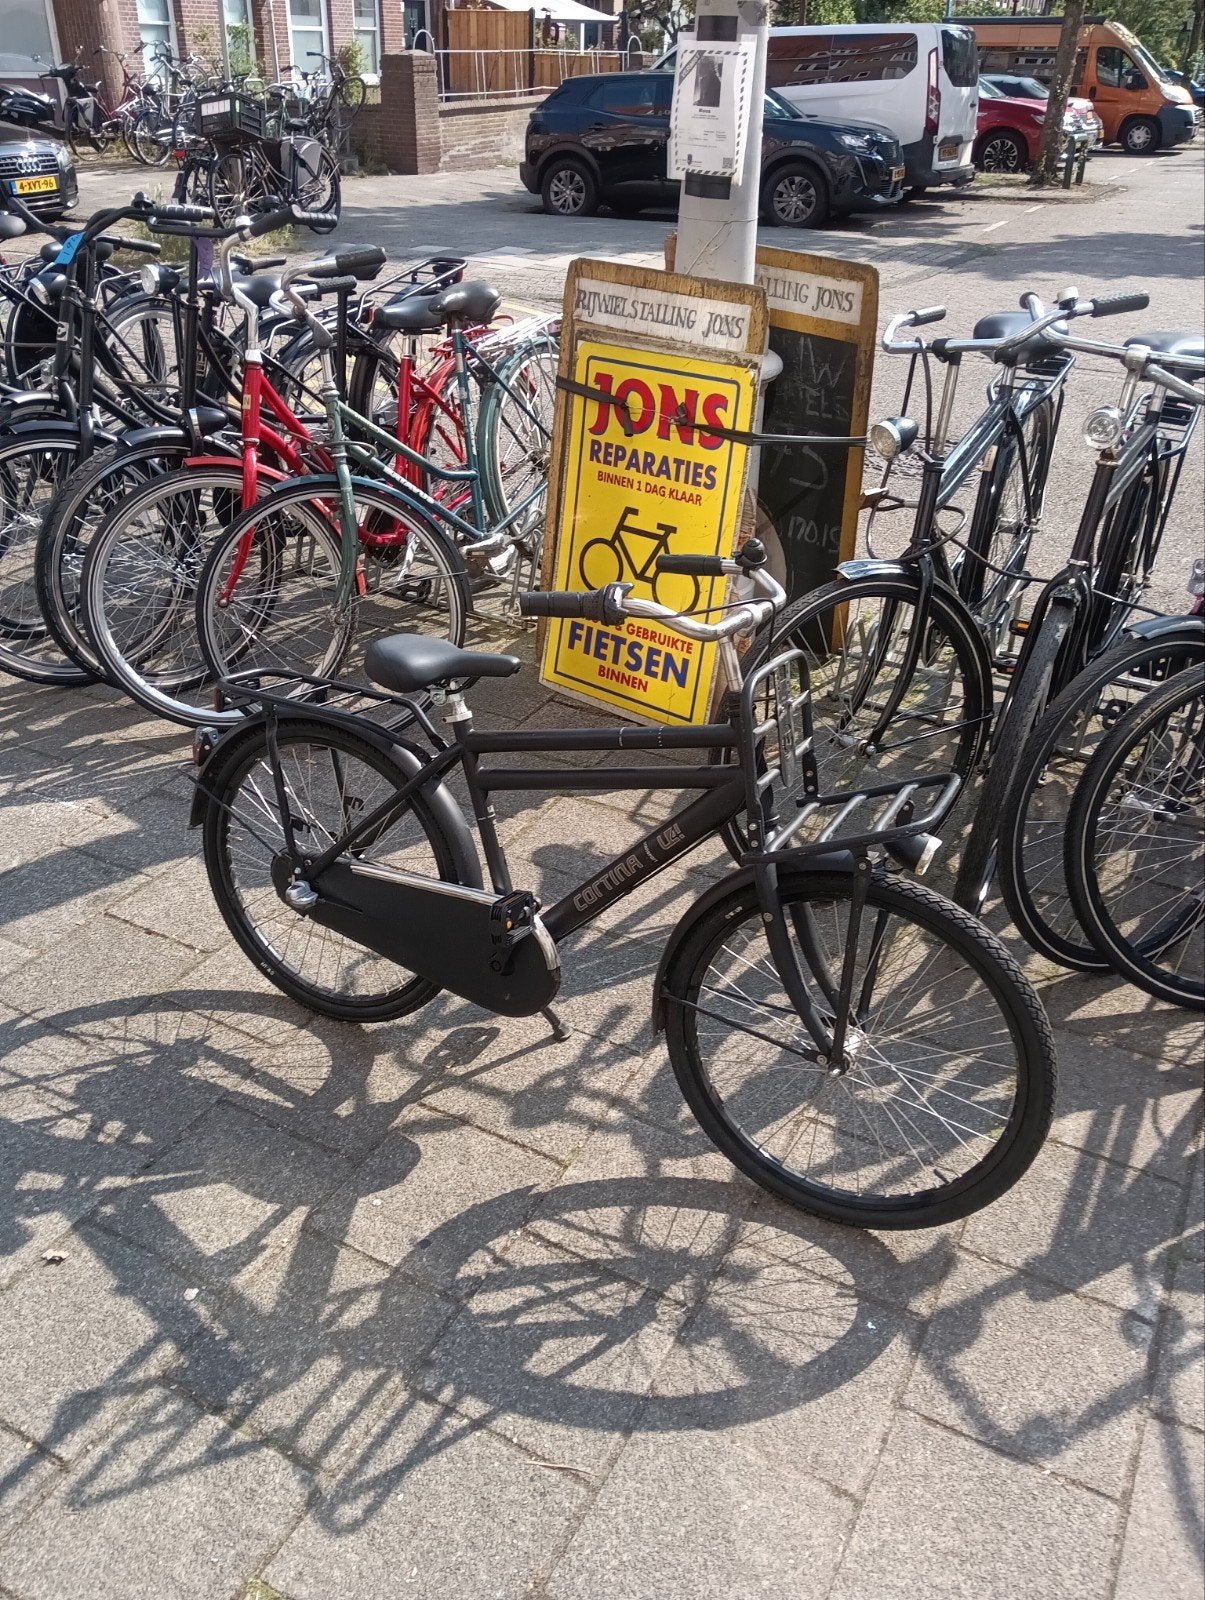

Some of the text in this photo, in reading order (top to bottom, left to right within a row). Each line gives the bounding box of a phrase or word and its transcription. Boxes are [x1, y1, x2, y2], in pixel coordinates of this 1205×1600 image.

[19, 178, 54, 191] 4-XVT-96
[574, 288, 746, 339] RIJWIELSTALLING JONS
[811, 286, 855, 313] JONS
[588, 371, 729, 451] JONS
[589, 438, 718, 491] REPARATIES
[597, 470, 703, 506] BINNEN 1 DAG KLAAR
[567, 620, 690, 689] FIETSEN
[626, 623, 694, 655] GEBRUIKTE
[597, 664, 649, 693] BINNEN
[573, 854, 644, 912] CORTINA
